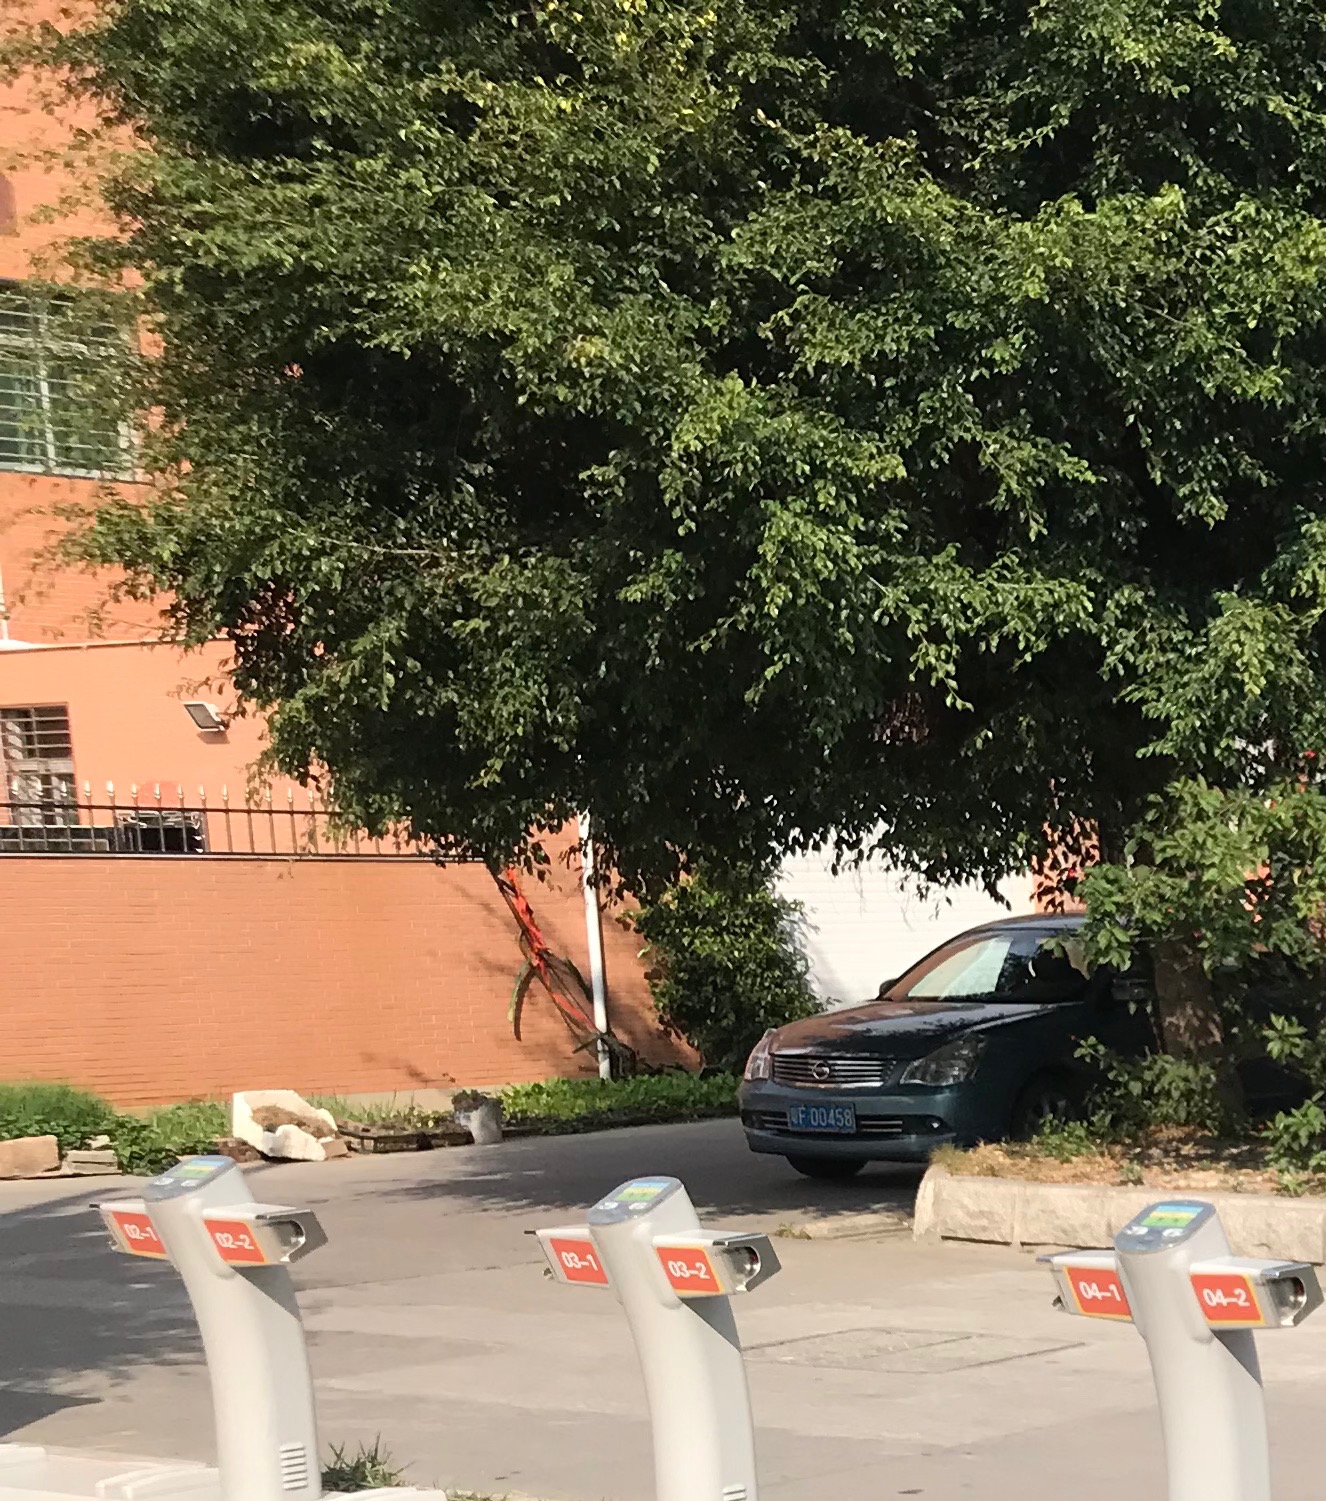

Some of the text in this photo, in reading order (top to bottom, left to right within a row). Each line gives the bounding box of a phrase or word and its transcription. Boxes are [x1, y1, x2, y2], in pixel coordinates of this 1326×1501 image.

[123, 1223, 158, 1242] 02-1
[215, 1232, 254, 1250] 02-2
[561, 1251, 598, 1271] 03-1
[668, 1260, 710, 1280] 03-2
[1078, 1281, 1122, 1302] 04-1
[1202, 1287, 1250, 1308] 04-2
